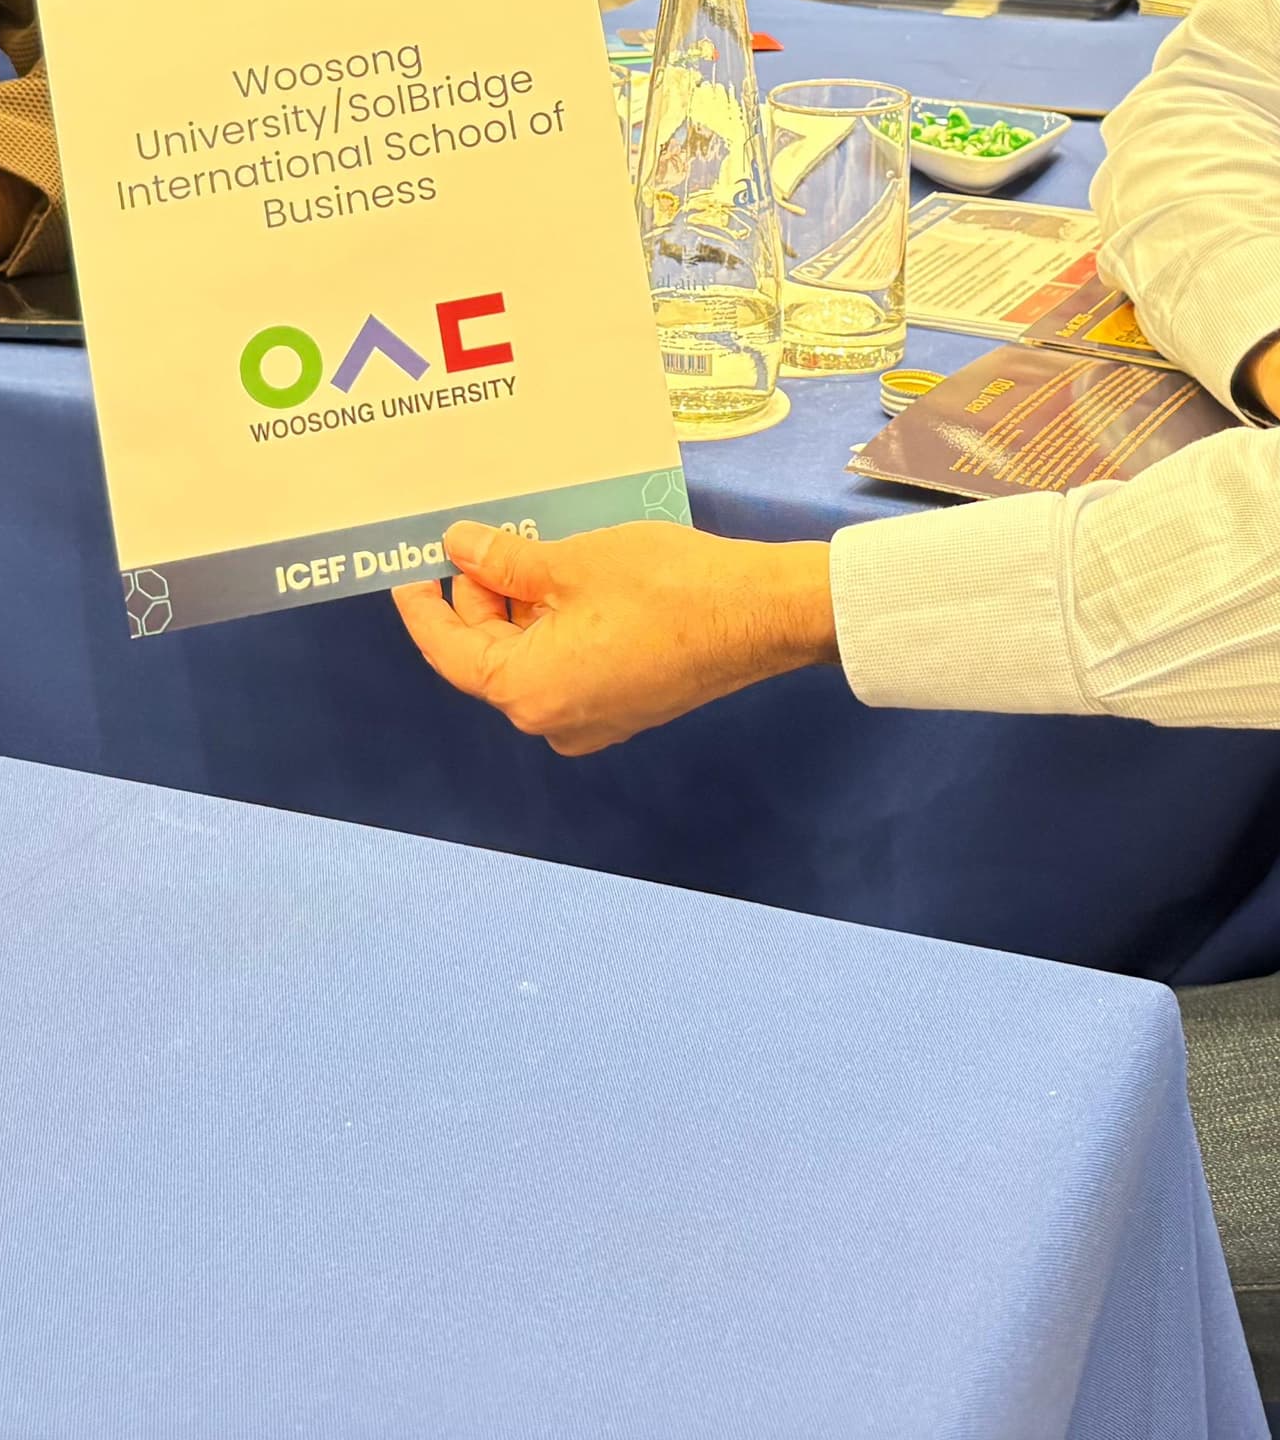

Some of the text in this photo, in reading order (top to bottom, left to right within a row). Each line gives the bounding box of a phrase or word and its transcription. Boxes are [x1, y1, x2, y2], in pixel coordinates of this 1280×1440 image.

[232, 43, 424, 99] Woosong
[135, 66, 535, 161] University/SolBridge
[117, 100, 566, 210] International School of
[263, 174, 437, 229] Business
[250, 375, 517, 443] WOOSONG UNIVERSITY
[275, 554, 346, 594] ICEF
[353, 532, 449, 578] Duba
